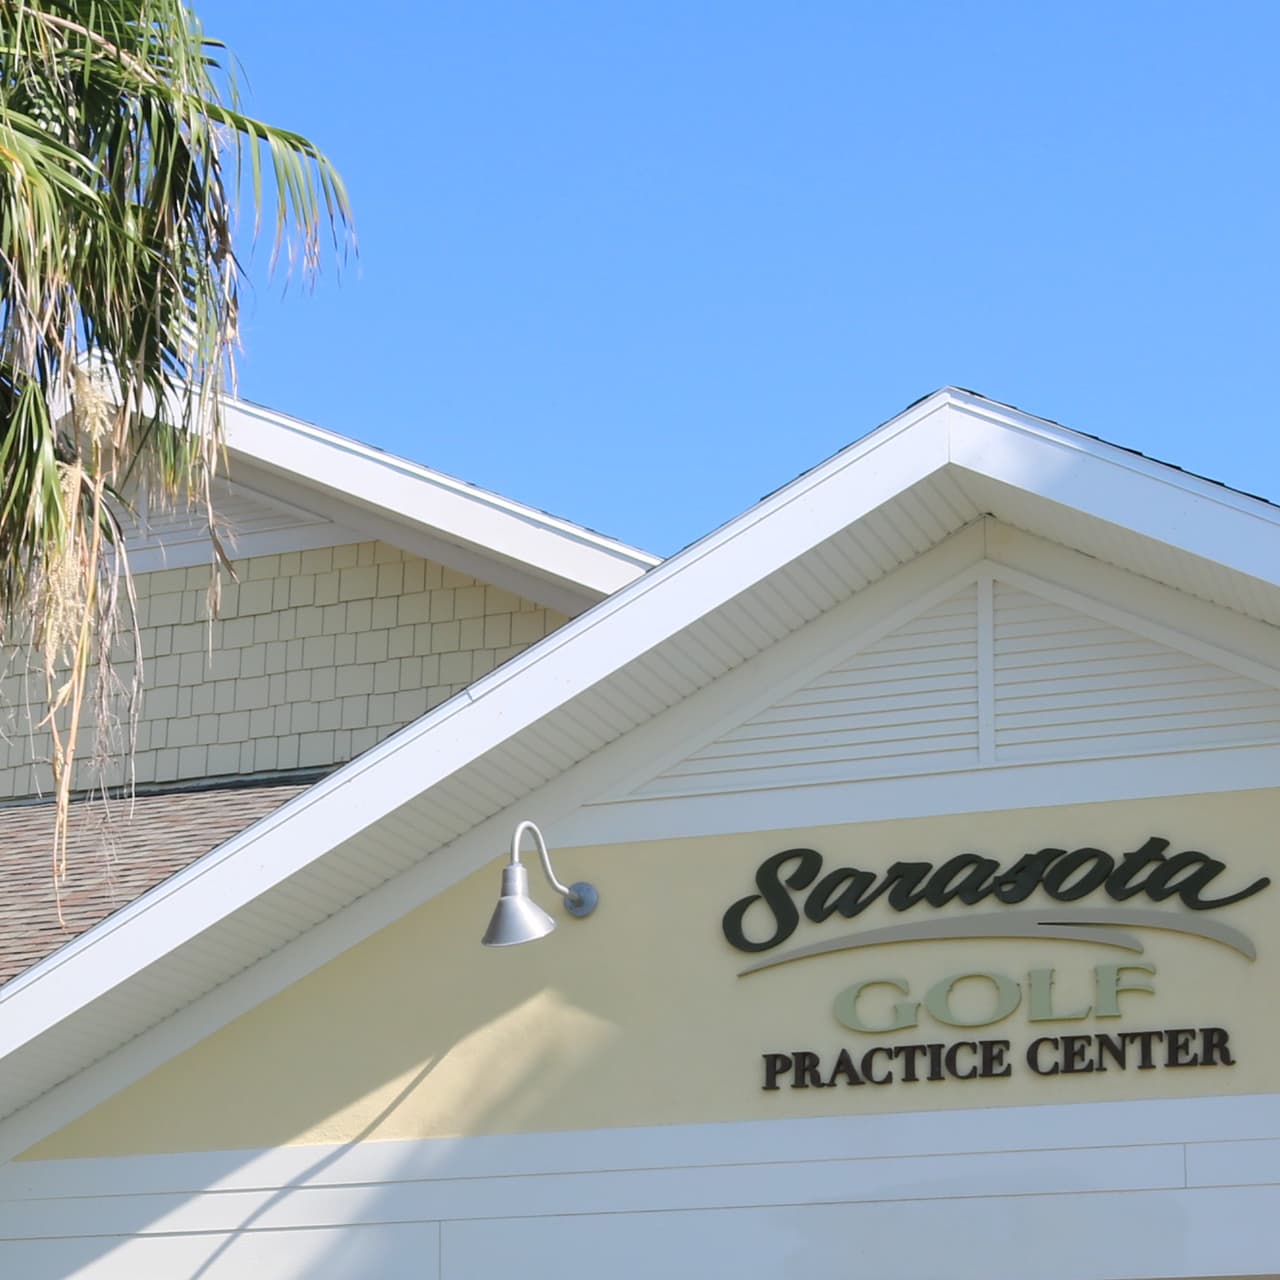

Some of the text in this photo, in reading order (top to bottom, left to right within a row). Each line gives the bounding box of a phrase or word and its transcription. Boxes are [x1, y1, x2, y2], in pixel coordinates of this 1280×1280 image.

[722, 836, 1271, 953] Sarasota
[831, 963, 1157, 1034] GOLF
[761, 1027, 1236, 1091] PRACTICE CENTER
